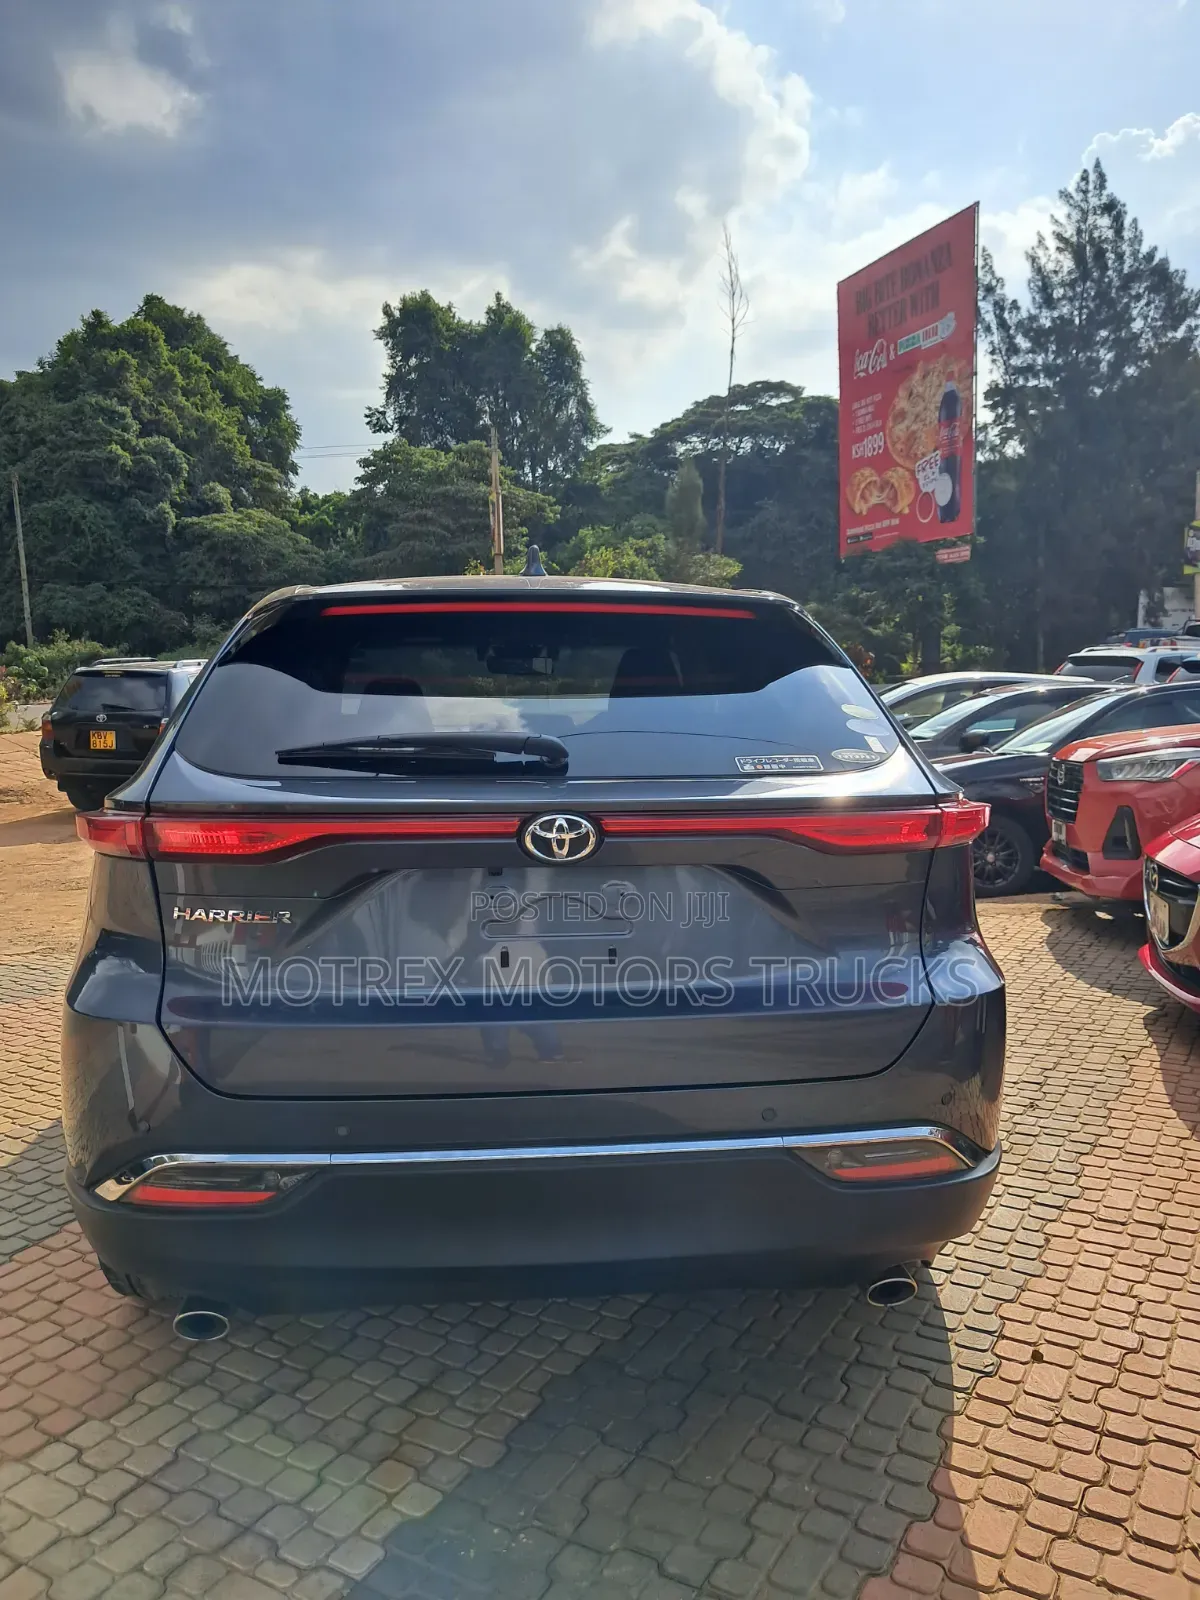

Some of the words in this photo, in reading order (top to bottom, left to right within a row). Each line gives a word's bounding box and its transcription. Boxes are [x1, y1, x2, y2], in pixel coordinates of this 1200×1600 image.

[917, 452, 940, 476] FREE
[91, 731, 108, 740] KBV
[173, 906, 292, 924] HARRIER
